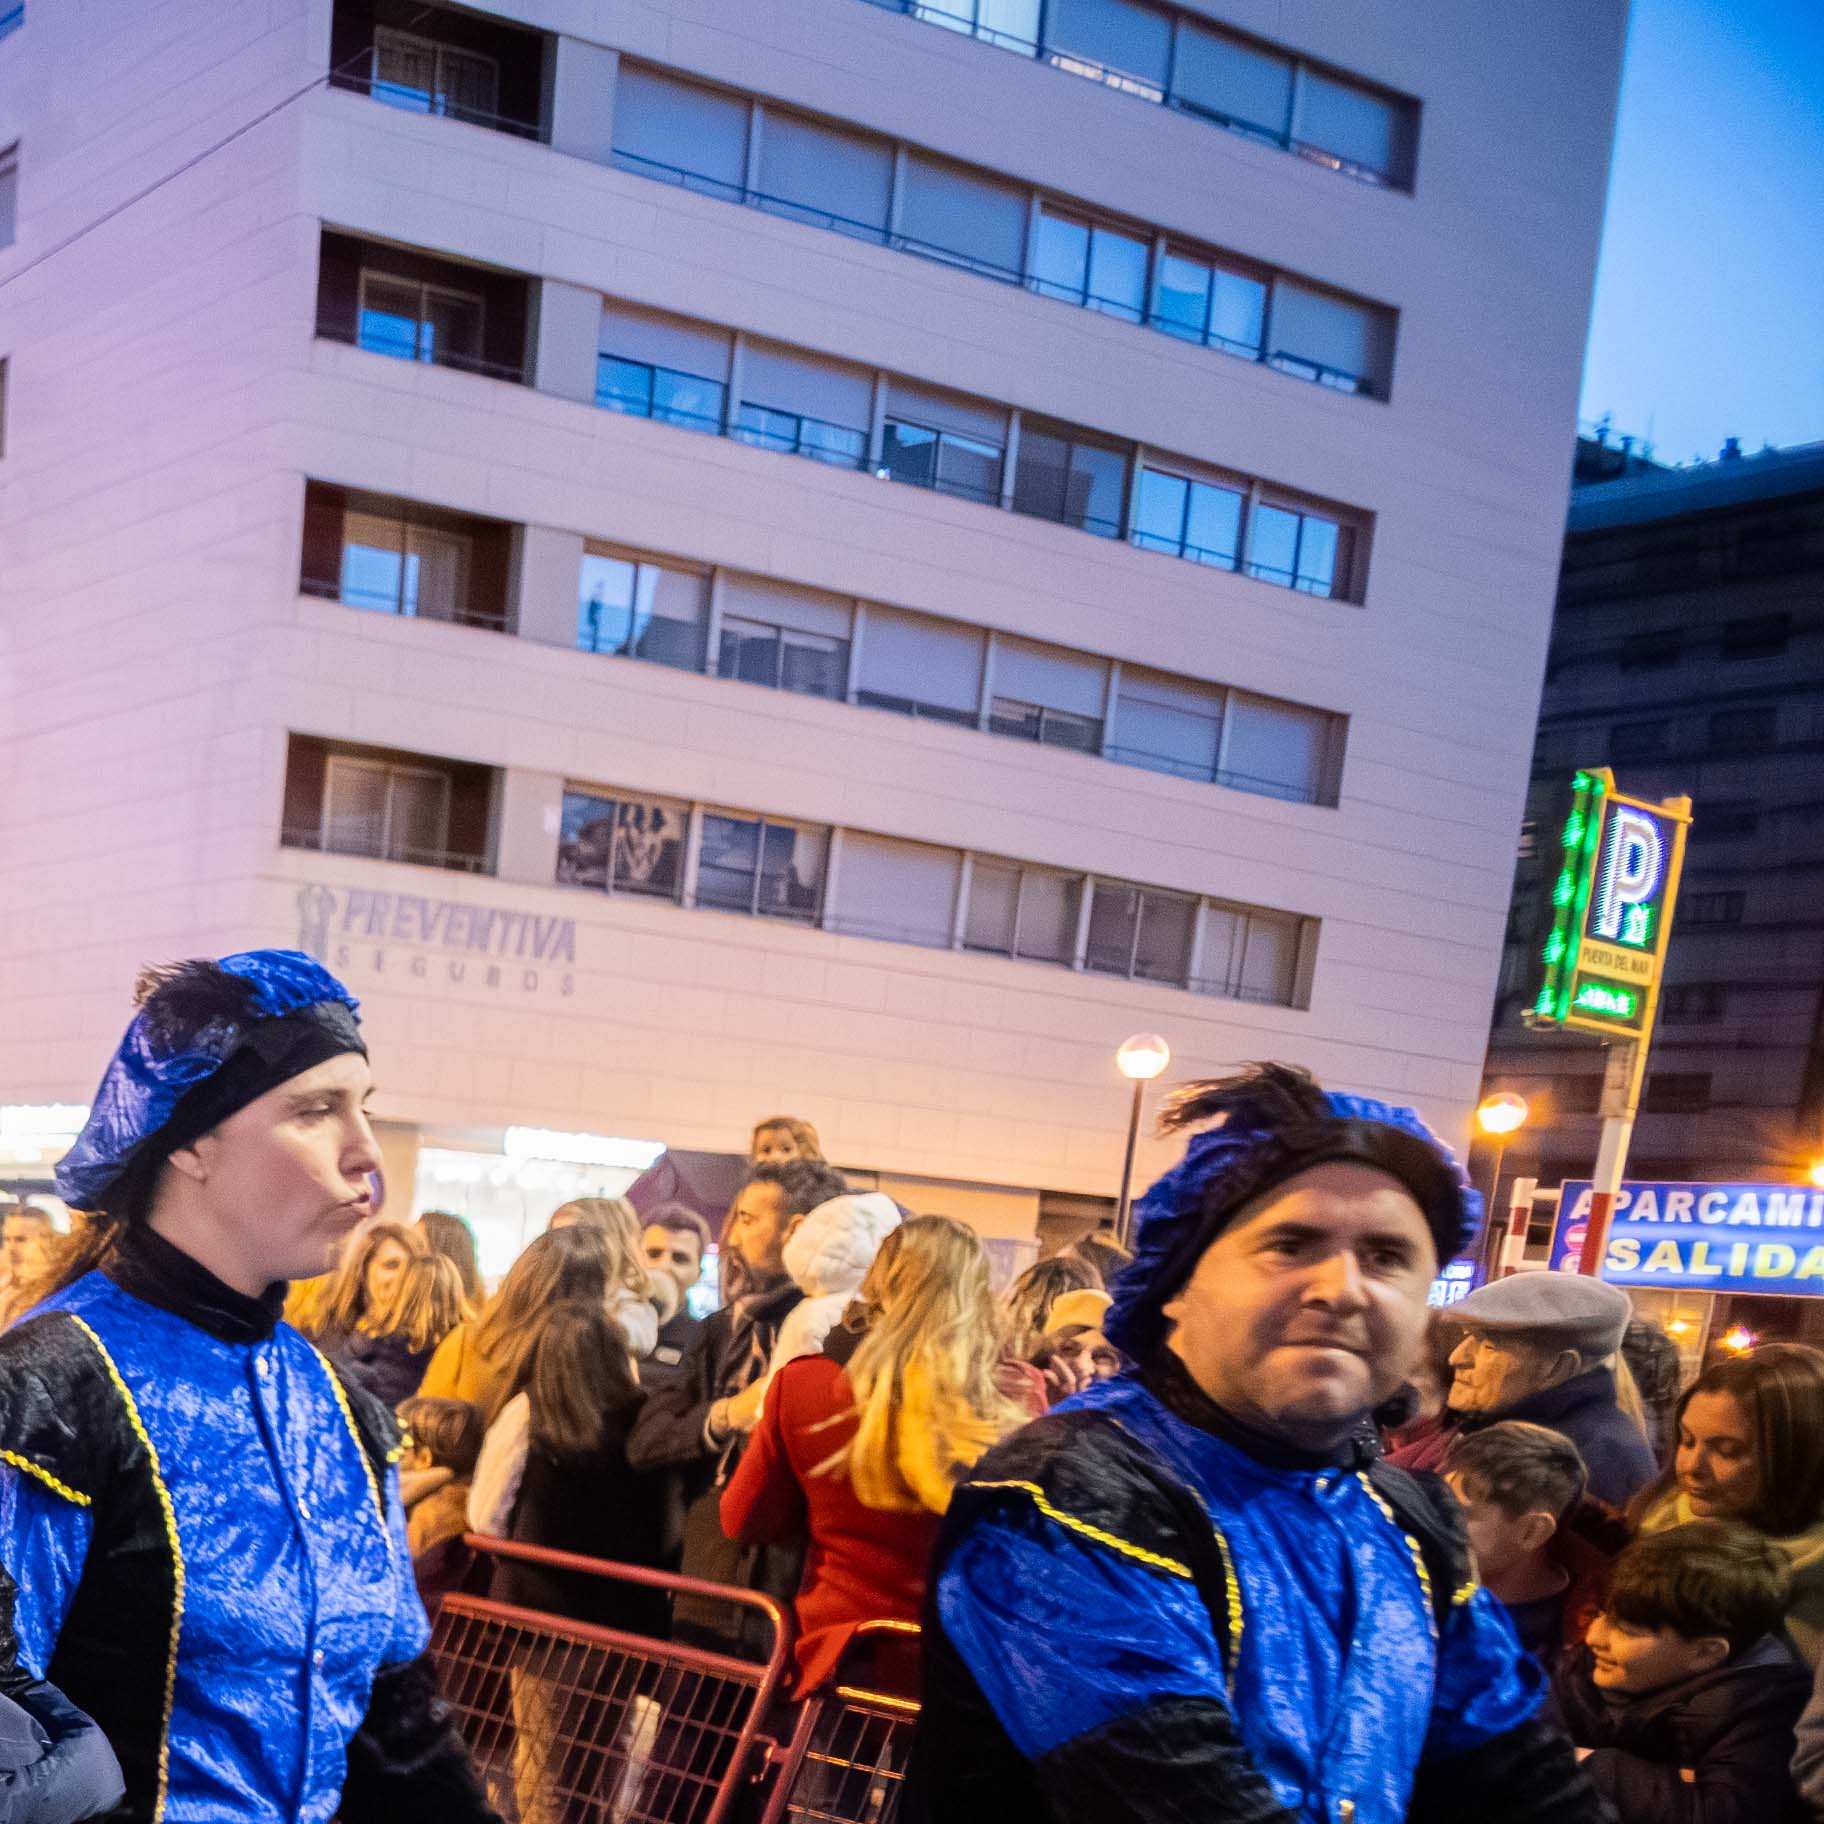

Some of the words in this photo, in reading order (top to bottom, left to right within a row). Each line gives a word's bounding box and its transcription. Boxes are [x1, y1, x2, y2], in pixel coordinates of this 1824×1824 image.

[1594, 805, 1668, 940] P
[343, 889, 577, 963] PREVENTIVA
[1605, 1238, 1824, 1280] SALIDA
